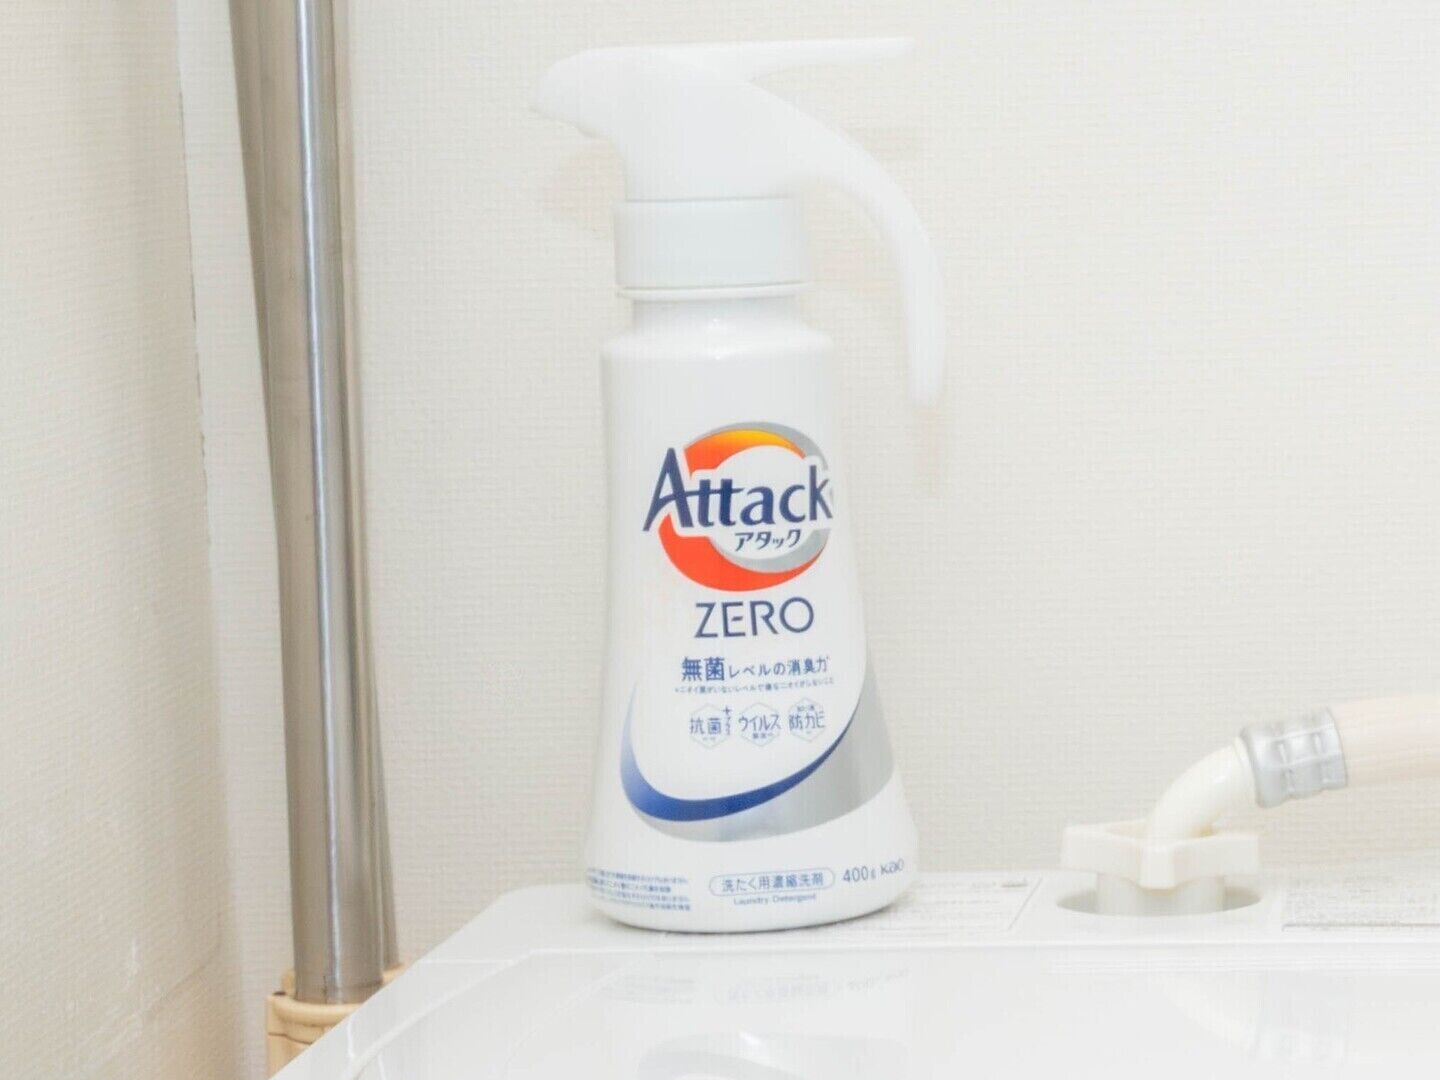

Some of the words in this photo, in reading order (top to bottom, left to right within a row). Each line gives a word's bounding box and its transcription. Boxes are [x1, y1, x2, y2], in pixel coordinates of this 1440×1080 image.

[642, 447, 833, 532] Attack
[733, 528, 802, 552] アタック
[694, 596, 815, 638] ZERO
